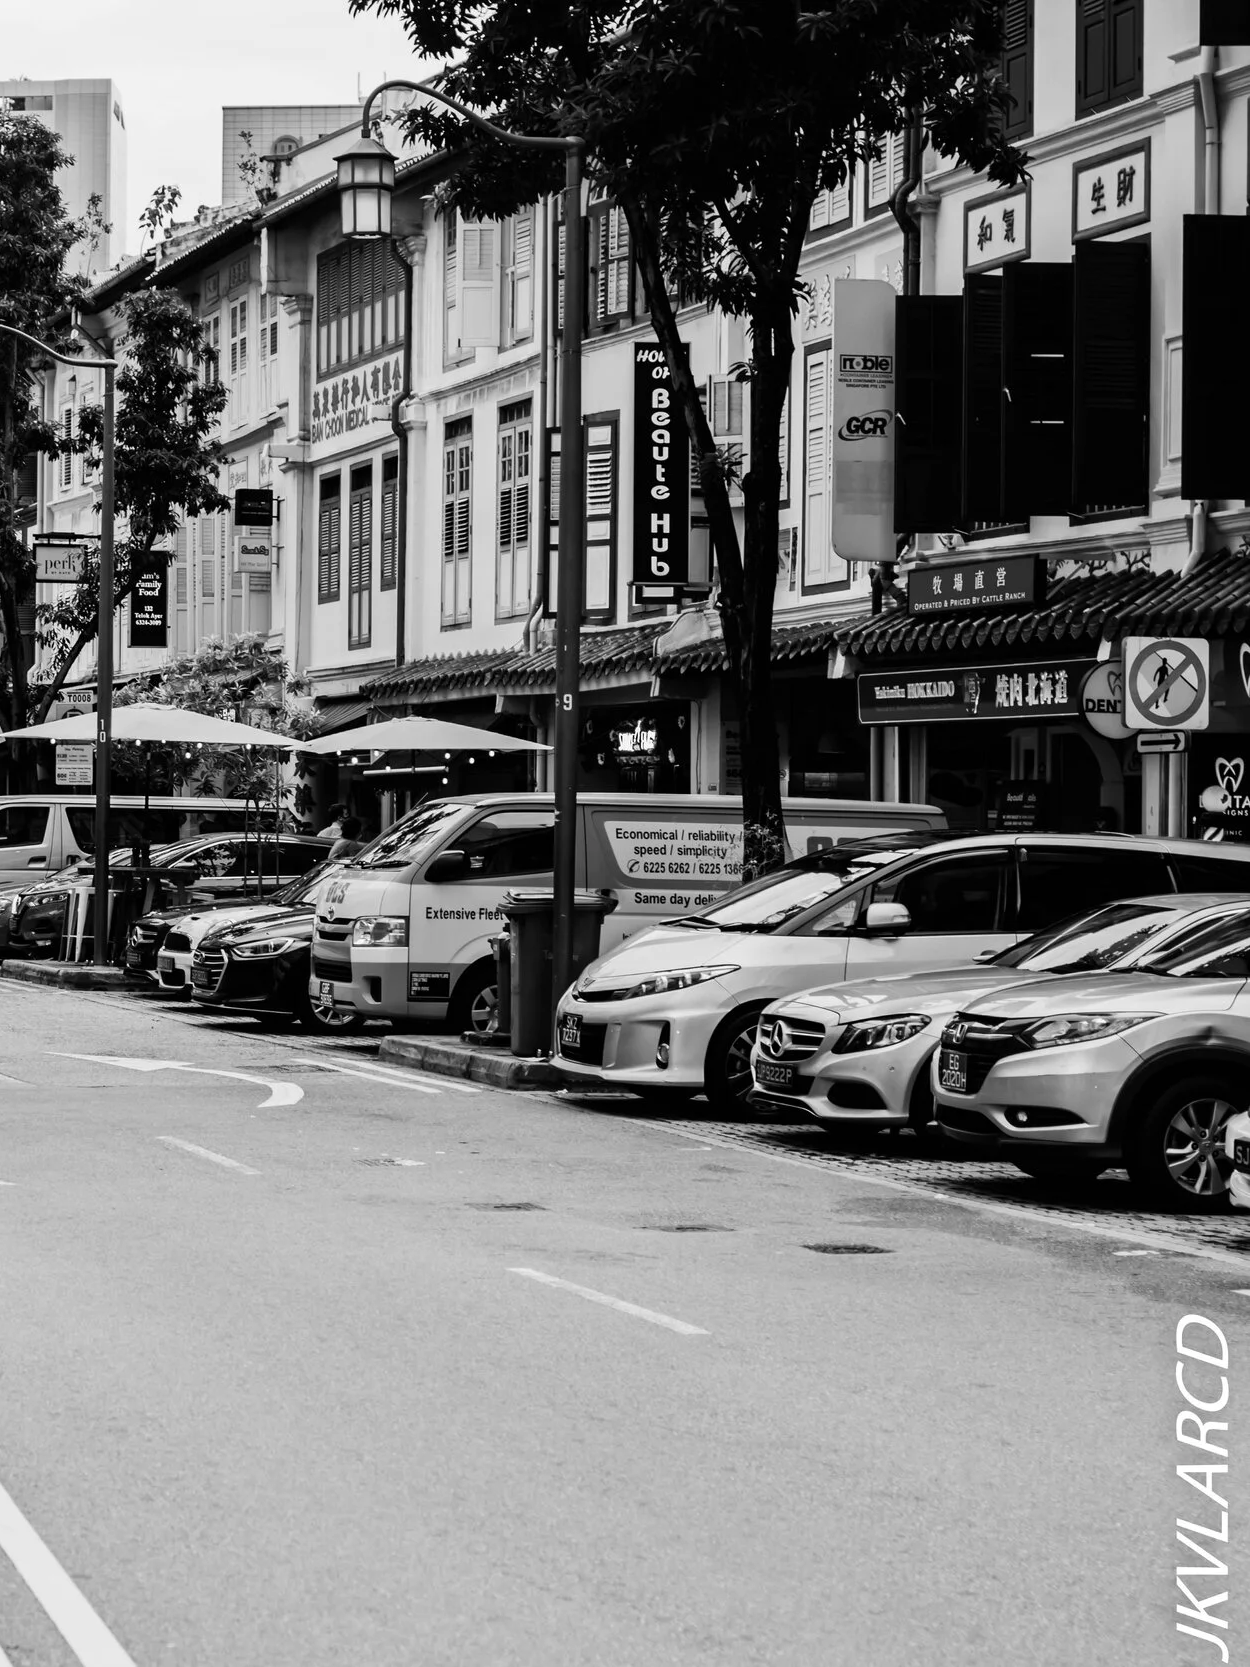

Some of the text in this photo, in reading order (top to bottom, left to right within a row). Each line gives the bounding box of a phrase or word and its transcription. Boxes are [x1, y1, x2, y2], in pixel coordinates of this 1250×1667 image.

[846, 416, 887, 435] GCR
[139, 588, 159, 596] Food
[914, 601, 943, 611] OPERATED
[950, 598, 971, 607] PRICED
[972, 596, 981, 605] BY
[981, 593, 1004, 603] CATTLE
[1005, 591, 1026, 600] RANCH
[907, 680, 956, 699] HOKKAIDO
[563, 694, 573, 711] 9
[1085, 698, 1122, 713] DEN
[615, 828, 678, 840] Economical
[688, 829, 735, 844] reliability
[634, 844, 667, 857] speed
[677, 844, 727, 859] simplicity
[643, 861, 666, 874] 6225
[668, 862, 690, 874] 6262
[699, 863, 721, 875] 6225
[634, 892, 667, 905] Same
[669, 893, 691, 909] day
[425, 906, 504, 921] Extensive Fleet
[949, 1053, 960, 1070] EG
[942, 1069, 967, 1088] 2020H
